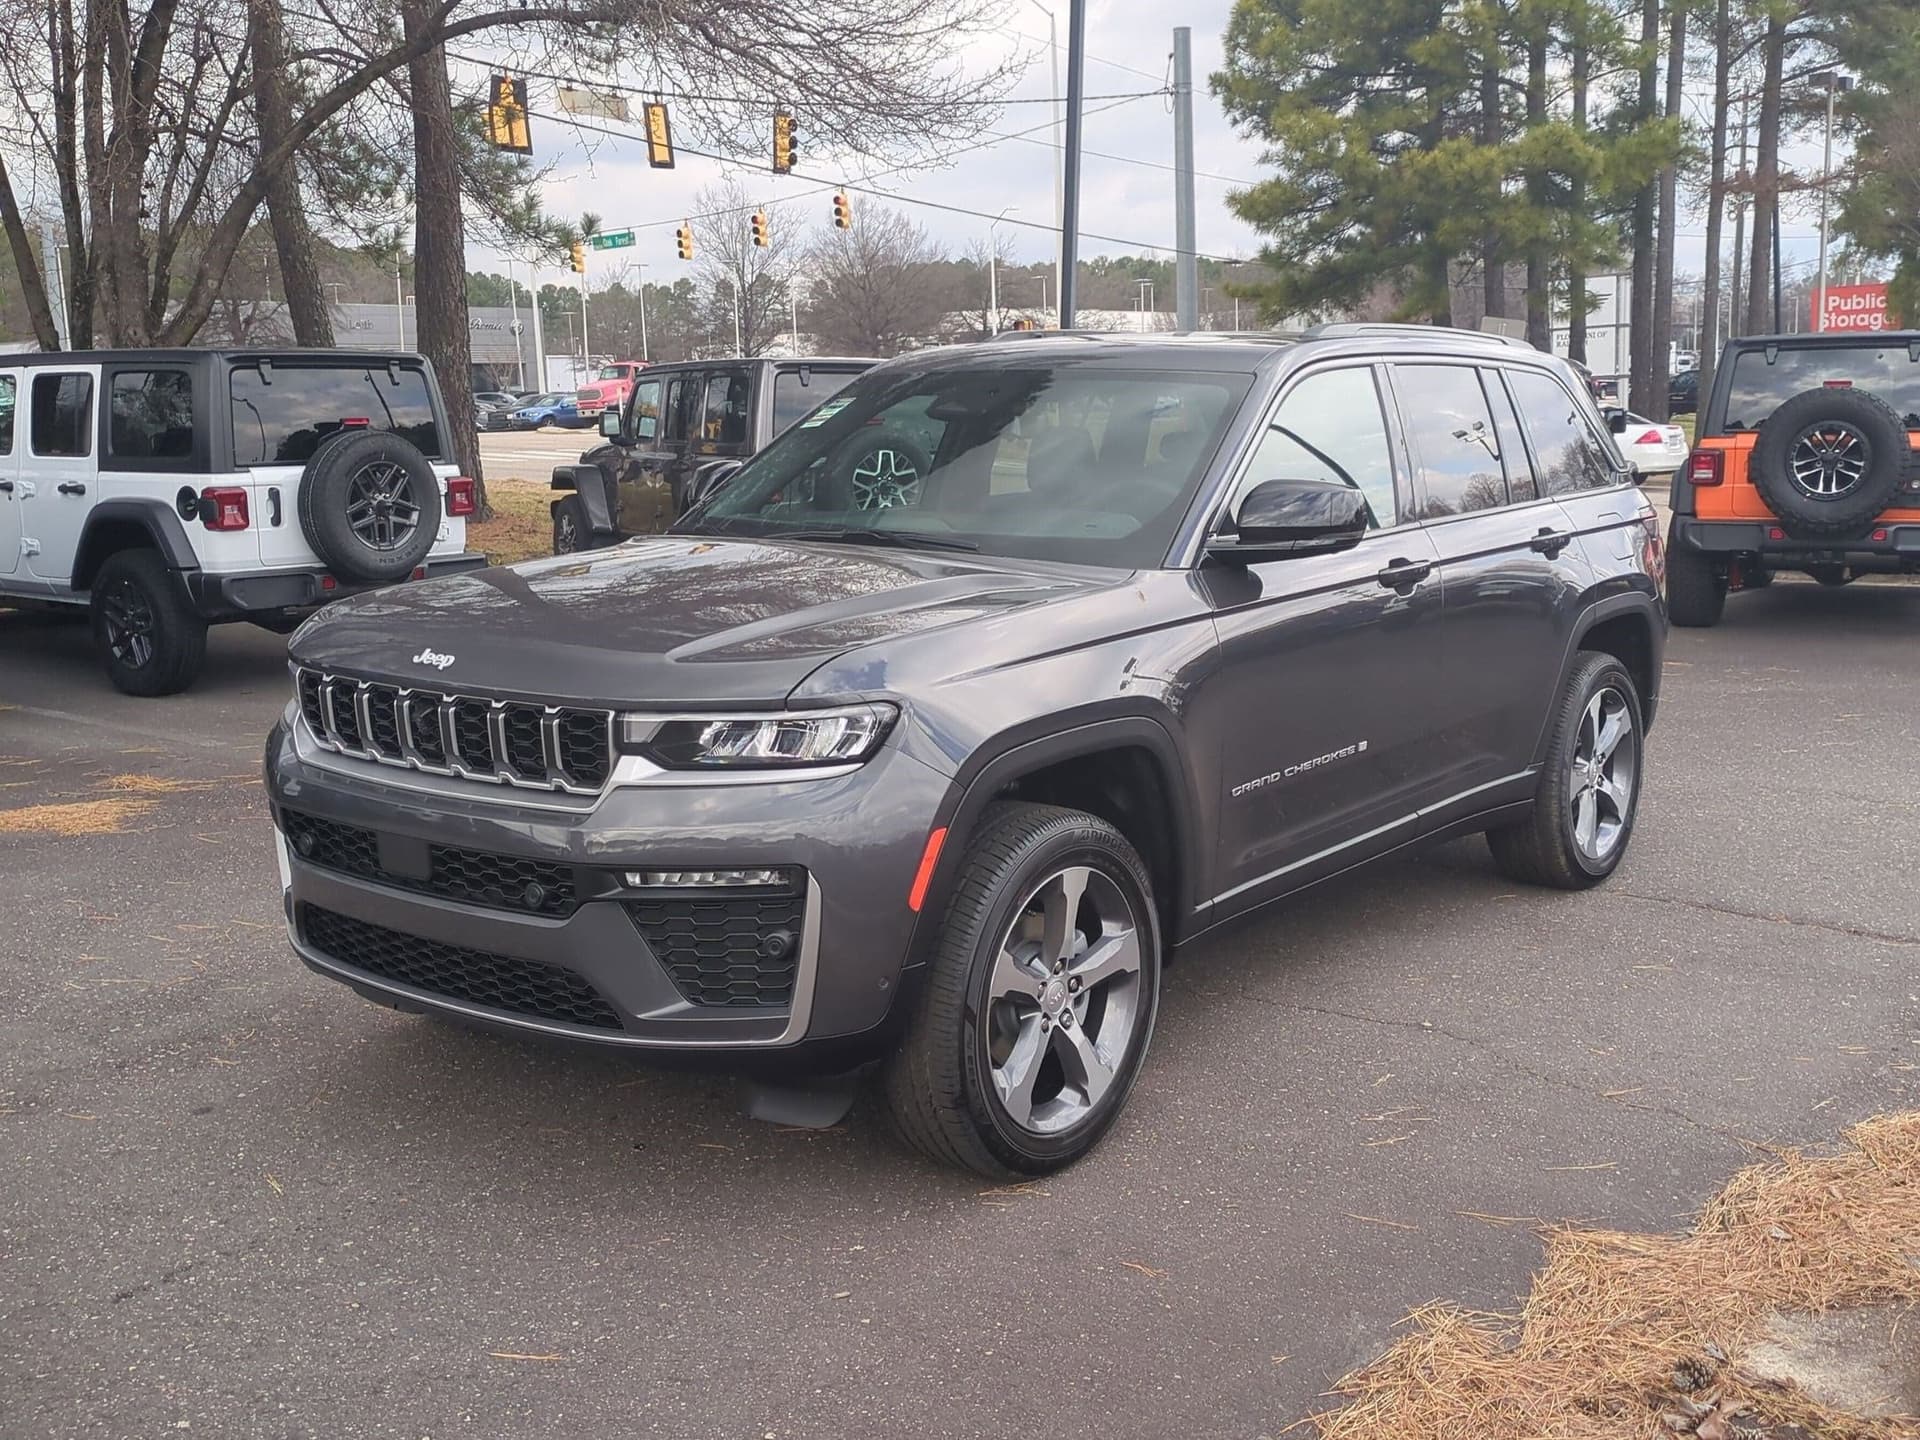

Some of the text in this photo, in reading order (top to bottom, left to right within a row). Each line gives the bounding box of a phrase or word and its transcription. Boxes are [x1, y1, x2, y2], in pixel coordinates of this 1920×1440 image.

[1828, 293, 1888, 312] Public
[412, 647, 456, 671] Jeep
[1231, 744, 1356, 797] GRAND CHEROKEE
